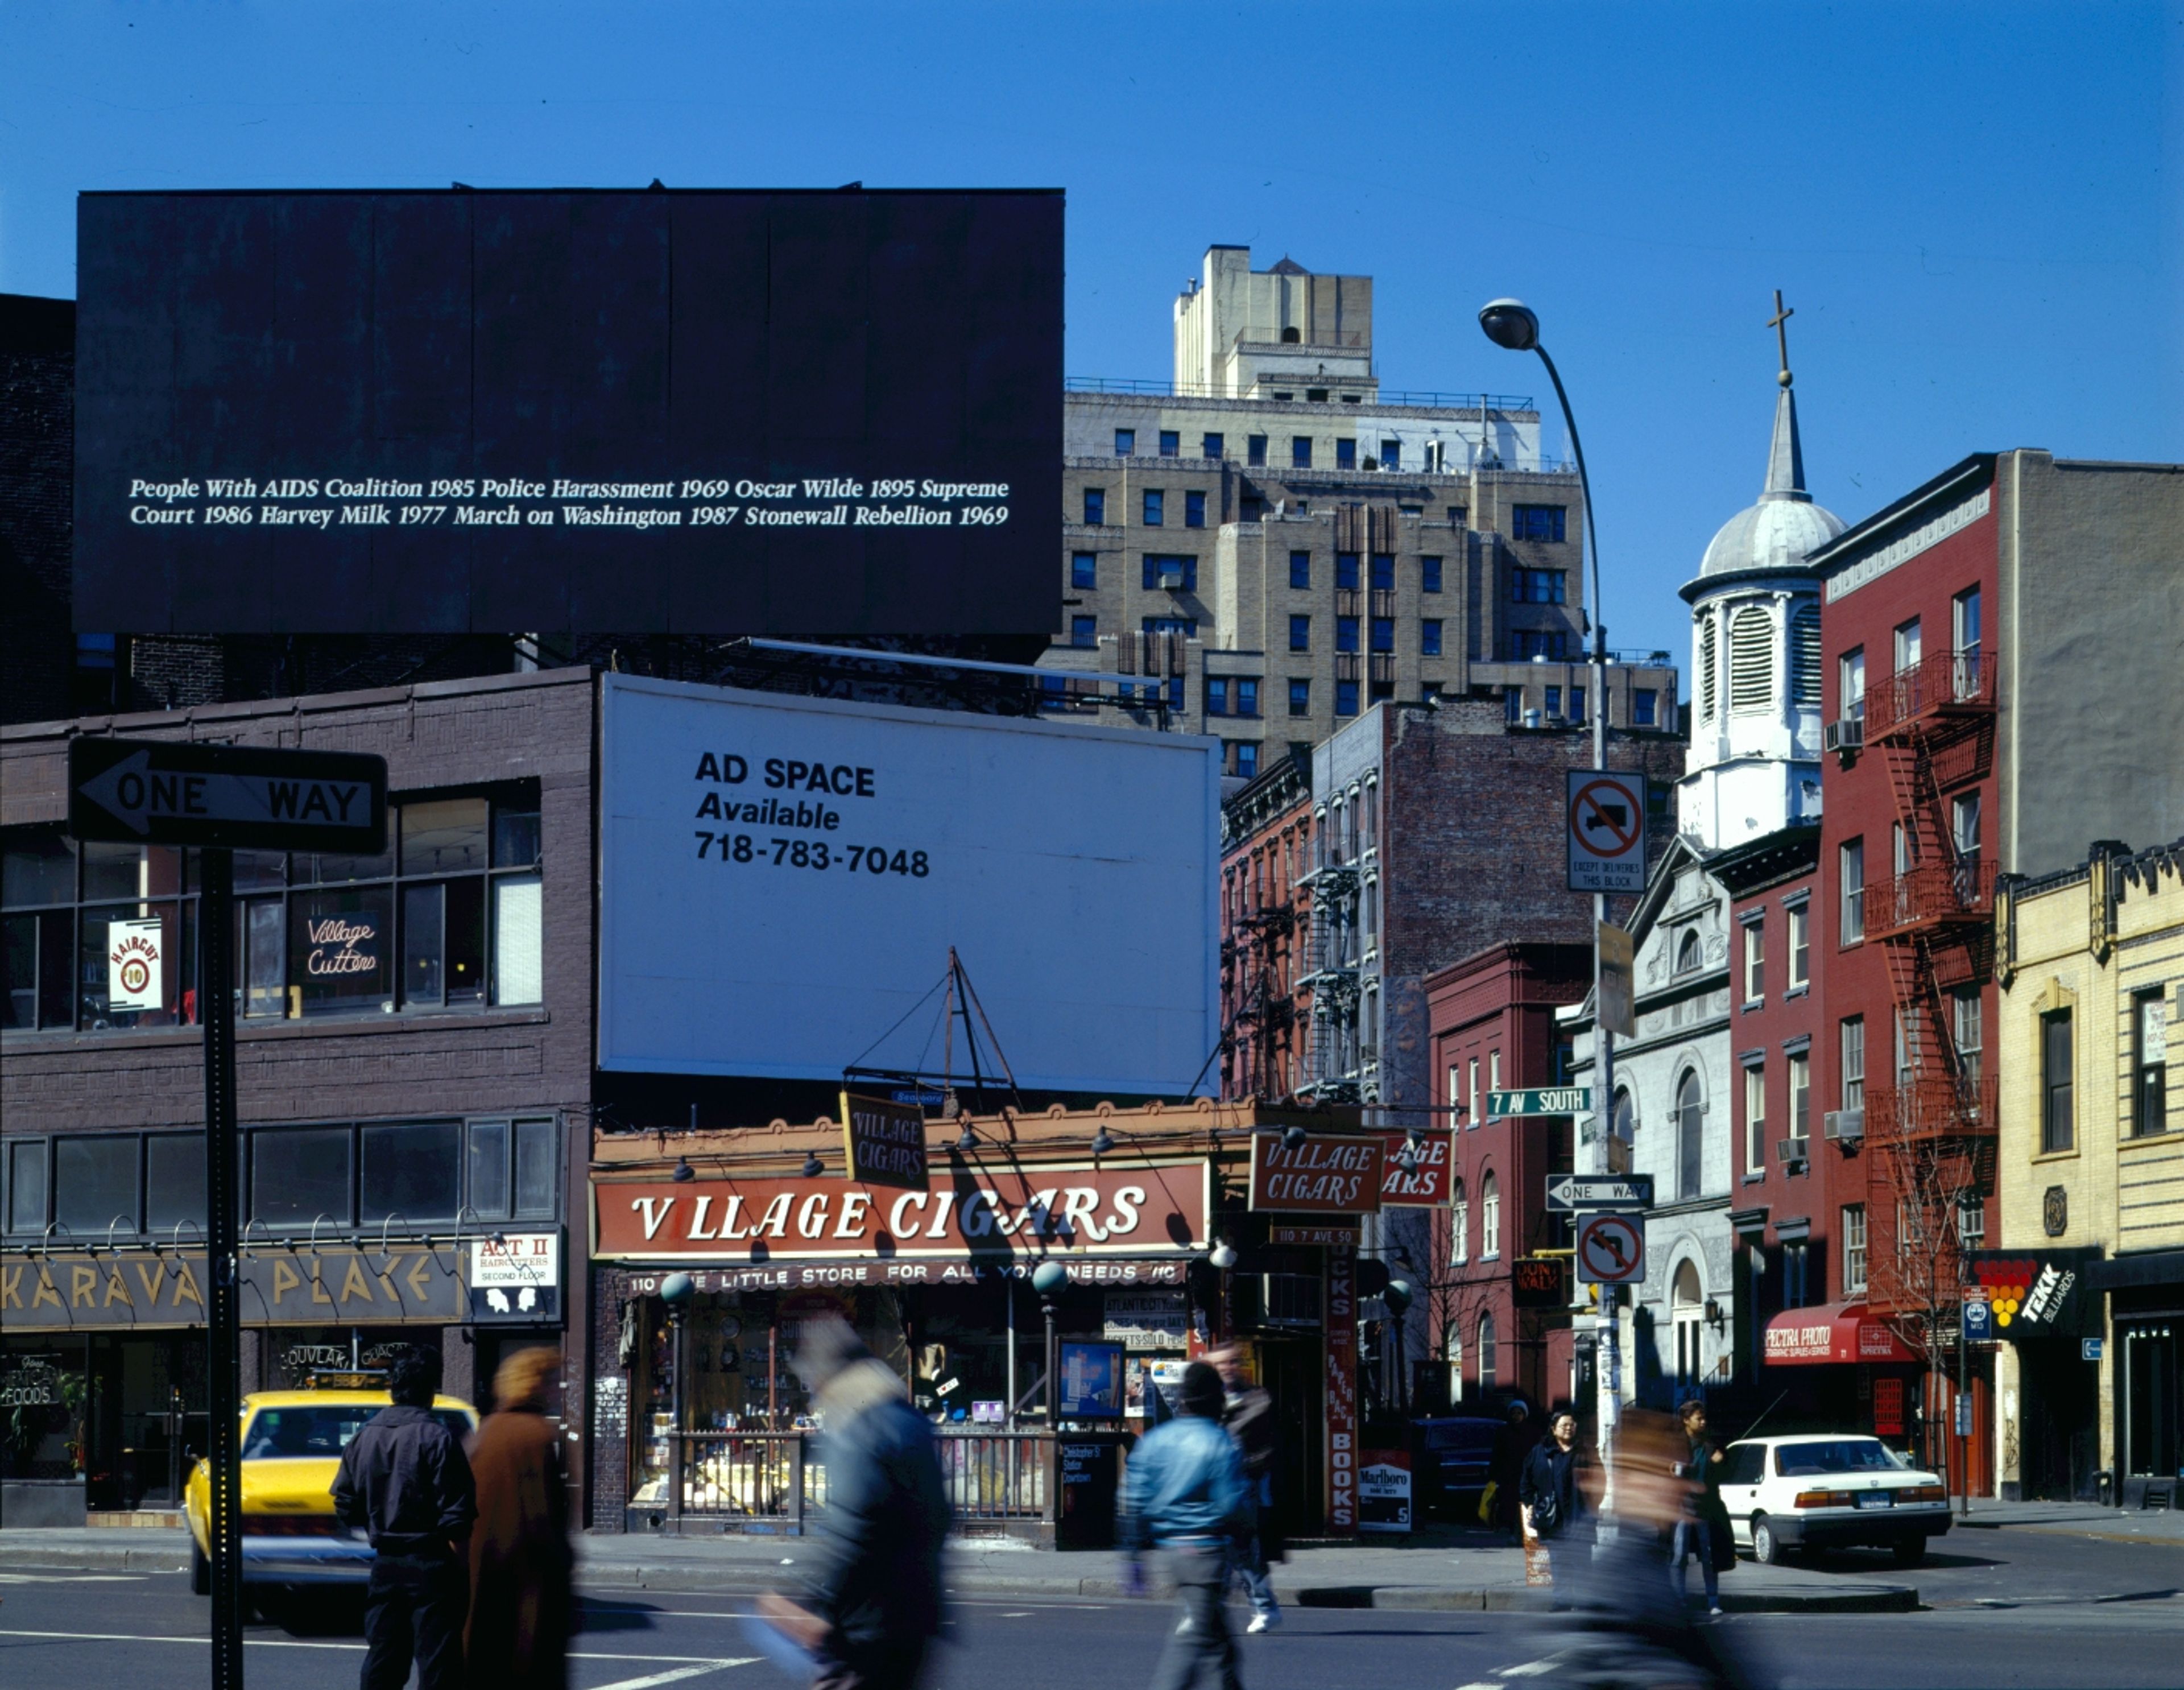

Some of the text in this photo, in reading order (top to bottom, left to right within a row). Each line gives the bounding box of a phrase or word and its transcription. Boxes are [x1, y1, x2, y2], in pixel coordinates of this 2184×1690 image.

[129, 478, 1009, 503] People With AIDS Coalition 1985 Police Harassment 1969 Oscar Wilde 1895 Supreme
[130, 504, 1008, 529] Court 1986 Harvey Milk 1977 March on Washington 1987 Stonewall Rebellion 1969
[695, 753, 875, 797] AD SPACE
[118, 772, 359, 821] ONE WAY
[695, 792, 839, 830] Available
[695, 831, 929, 878] 718-783-7048
[1573, 861, 1639, 874] EXCEPT DELIVERIES
[1583, 875, 1631, 887] THIS BLOCK
[308, 919, 375, 948] Village
[111, 936, 159, 965] HAIRCUT
[308, 948, 377, 974] Cutters
[897, 1092, 944, 1103] Seaoard
[1493, 1090, 1583, 1113] 7 AV SOUTH
[853, 1112, 920, 1144] VILLAGE
[857, 1140, 923, 1181] CIGARS
[1265, 1143, 1376, 1171] VILLAGE
[1267, 1175, 1362, 1206] CIGARS
[1381, 1169, 1439, 1195] ARS
[1562, 1185, 1645, 1199] ONE WAY
[632, 1185, 1147, 1242] VLLAGE CIGARS
[480, 1238, 548, 1257] ACT II
[1280, 1229, 1295, 1241] 110
[1301, 1230, 1308, 1242] 7
[1313, 1230, 1332, 1243] AVE
[1, 1255, 431, 1309] KARAVA PLACE
[482, 1271, 546, 1281] SECOND FLOOR
[632, 1278, 655, 1291] 110
[721, 1271, 788, 1288] LITTLE
[802, 1268, 867, 1283] STORE
[888, 1265, 927, 1279] FOR
[942, 1265, 986, 1278] ALL
[997, 1265, 1032, 1279] YO
[1067, 1265, 1137, 1279] NEEDS
[1518, 1274, 1558, 1291] WALK
[2020, 1261, 2062, 1323] TEKK
[2042, 1269, 2076, 1324] BILLIARDS
[1765, 1325, 1831, 1348] PECTRA PHOTO
[1328, 1354, 1352, 1402] PAPER
[6, 1386, 51, 1405] FOODS
[1329, 1390, 1354, 1430] BACK
[1333, 1433, 1353, 1526] BOOKS
[1359, 1469, 1407, 1485] Marlboro
